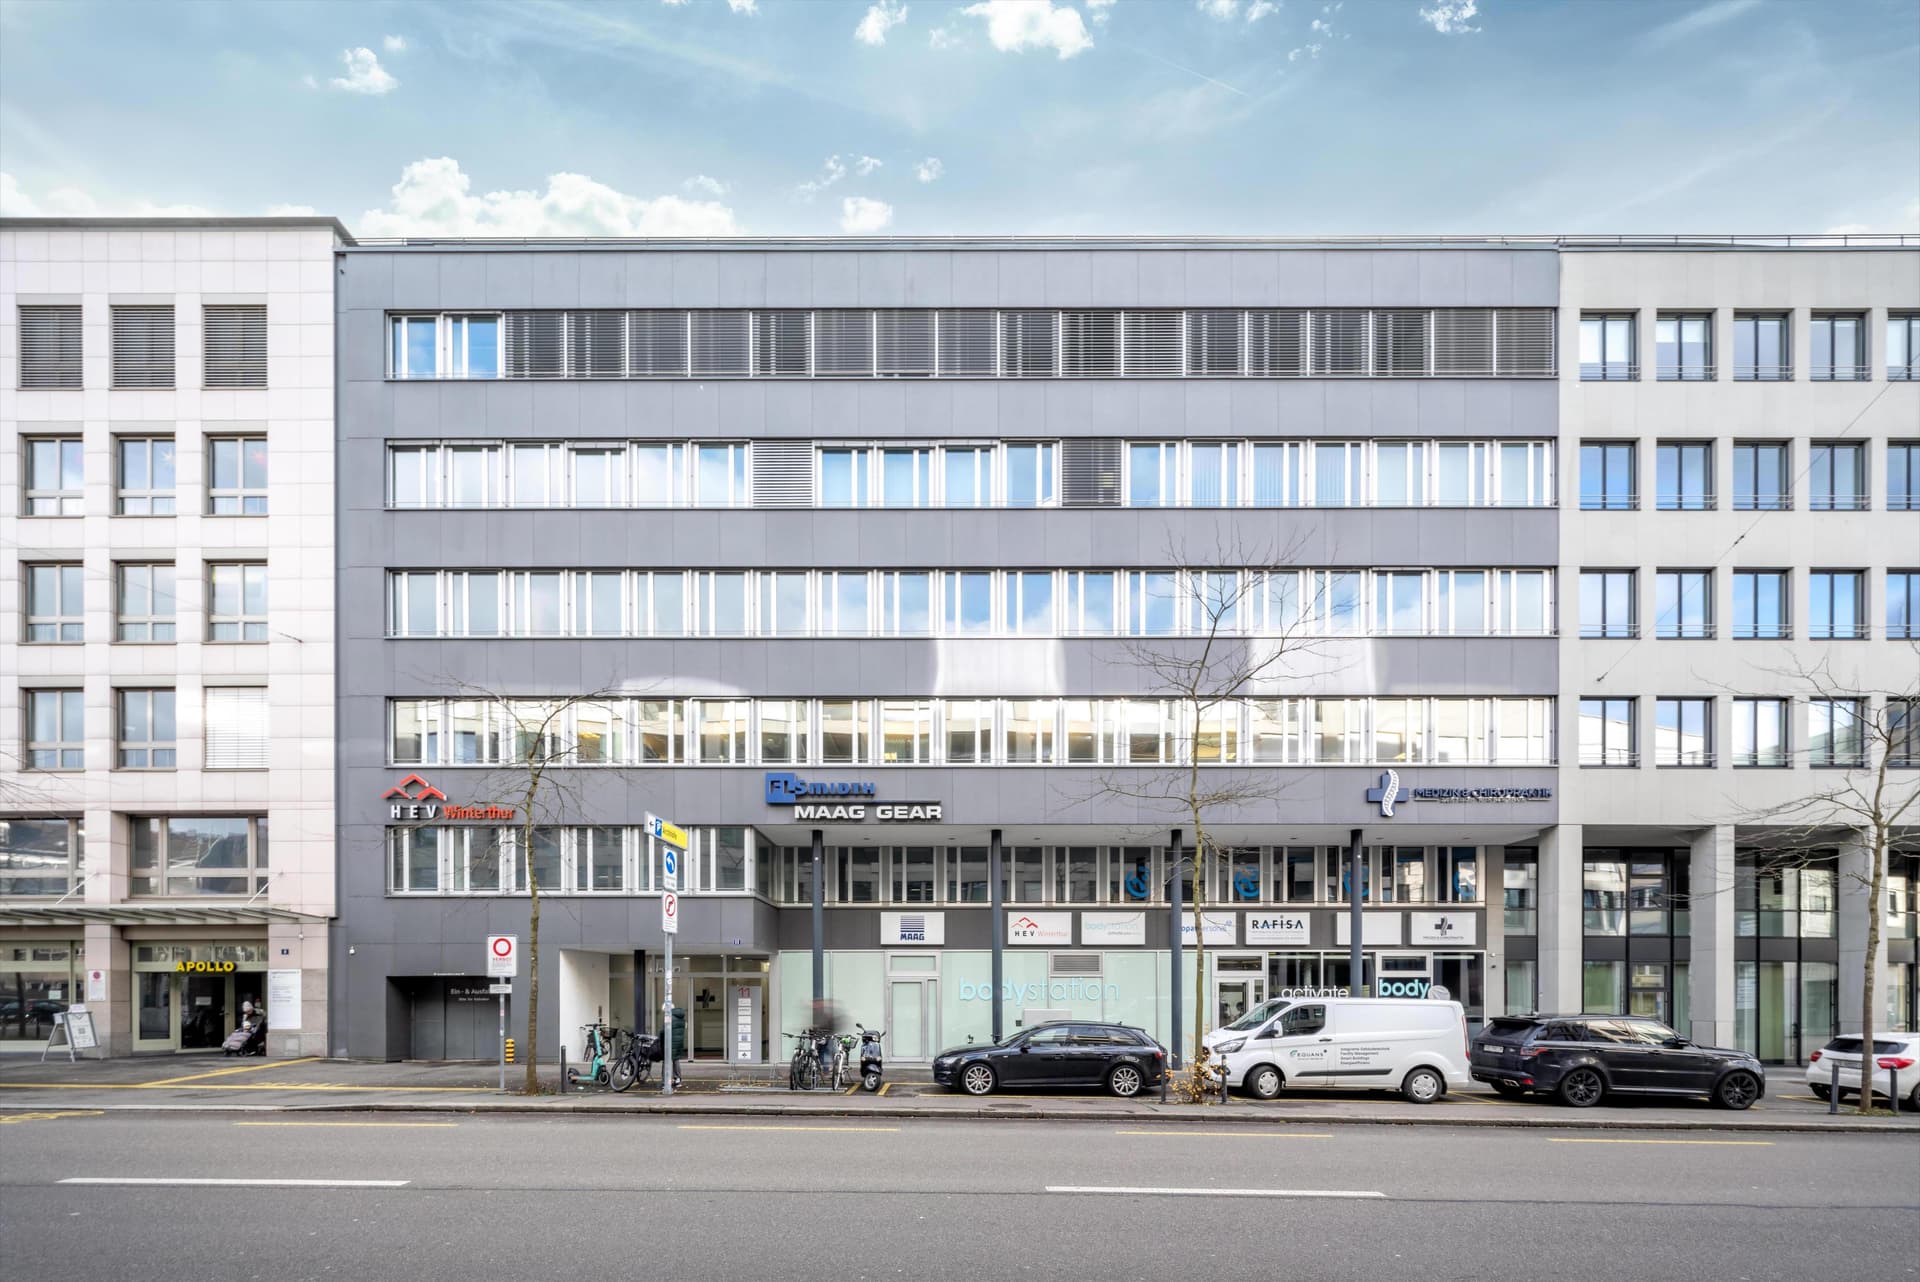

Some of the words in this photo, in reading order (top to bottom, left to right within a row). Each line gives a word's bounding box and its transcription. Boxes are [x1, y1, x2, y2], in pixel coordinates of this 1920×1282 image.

[390, 804, 437, 819] HEV
[443, 805, 515, 819] Winterthur
[794, 805, 865, 819] MAAG
[876, 805, 942, 819] GEAR
[900, 933, 925, 941] MAAG
[175, 961, 235, 972] APOLLO
[959, 976, 1121, 1007] bodystation
[1281, 985, 1349, 998] activate
[1379, 979, 1430, 999] body
